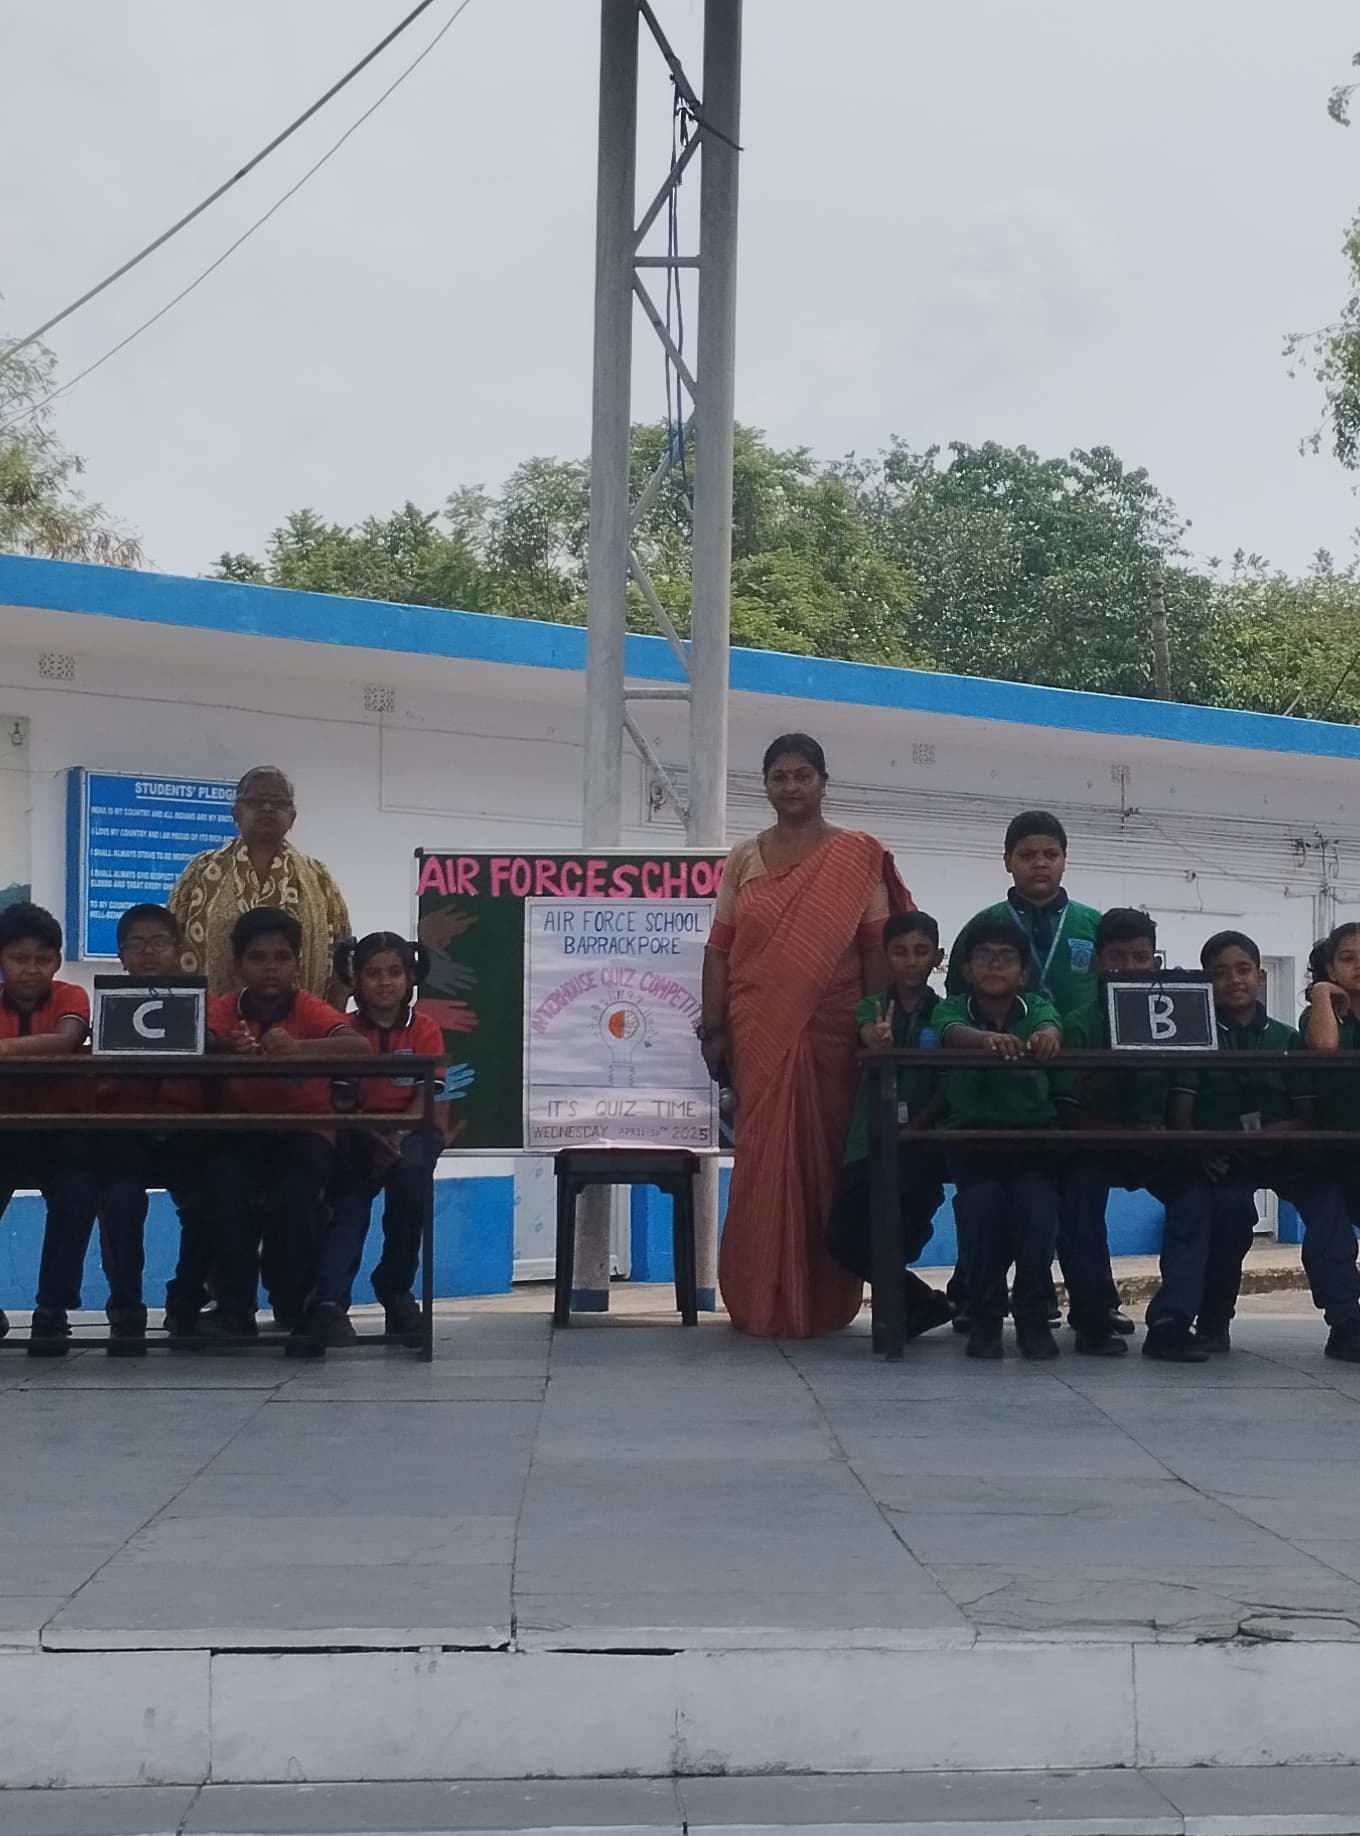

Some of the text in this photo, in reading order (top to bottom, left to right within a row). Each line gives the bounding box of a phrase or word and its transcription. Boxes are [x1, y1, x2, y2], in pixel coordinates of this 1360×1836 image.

[135, 782, 195, 797] STUDENTS'
[416, 857, 480, 896] AIR
[608, 858, 727, 899] SCHO
[544, 911, 703, 933] AIR FORCE SCHOOL
[564, 936, 681, 955] BARRACKPORE
[601, 966, 637, 988] QUIZ
[133, 1001, 165, 1038] C
[1148, 995, 1177, 1039] B
[548, 1100, 697, 1120] IT'S QUIZ TIME
[671, 1126, 708, 1141] 2025
